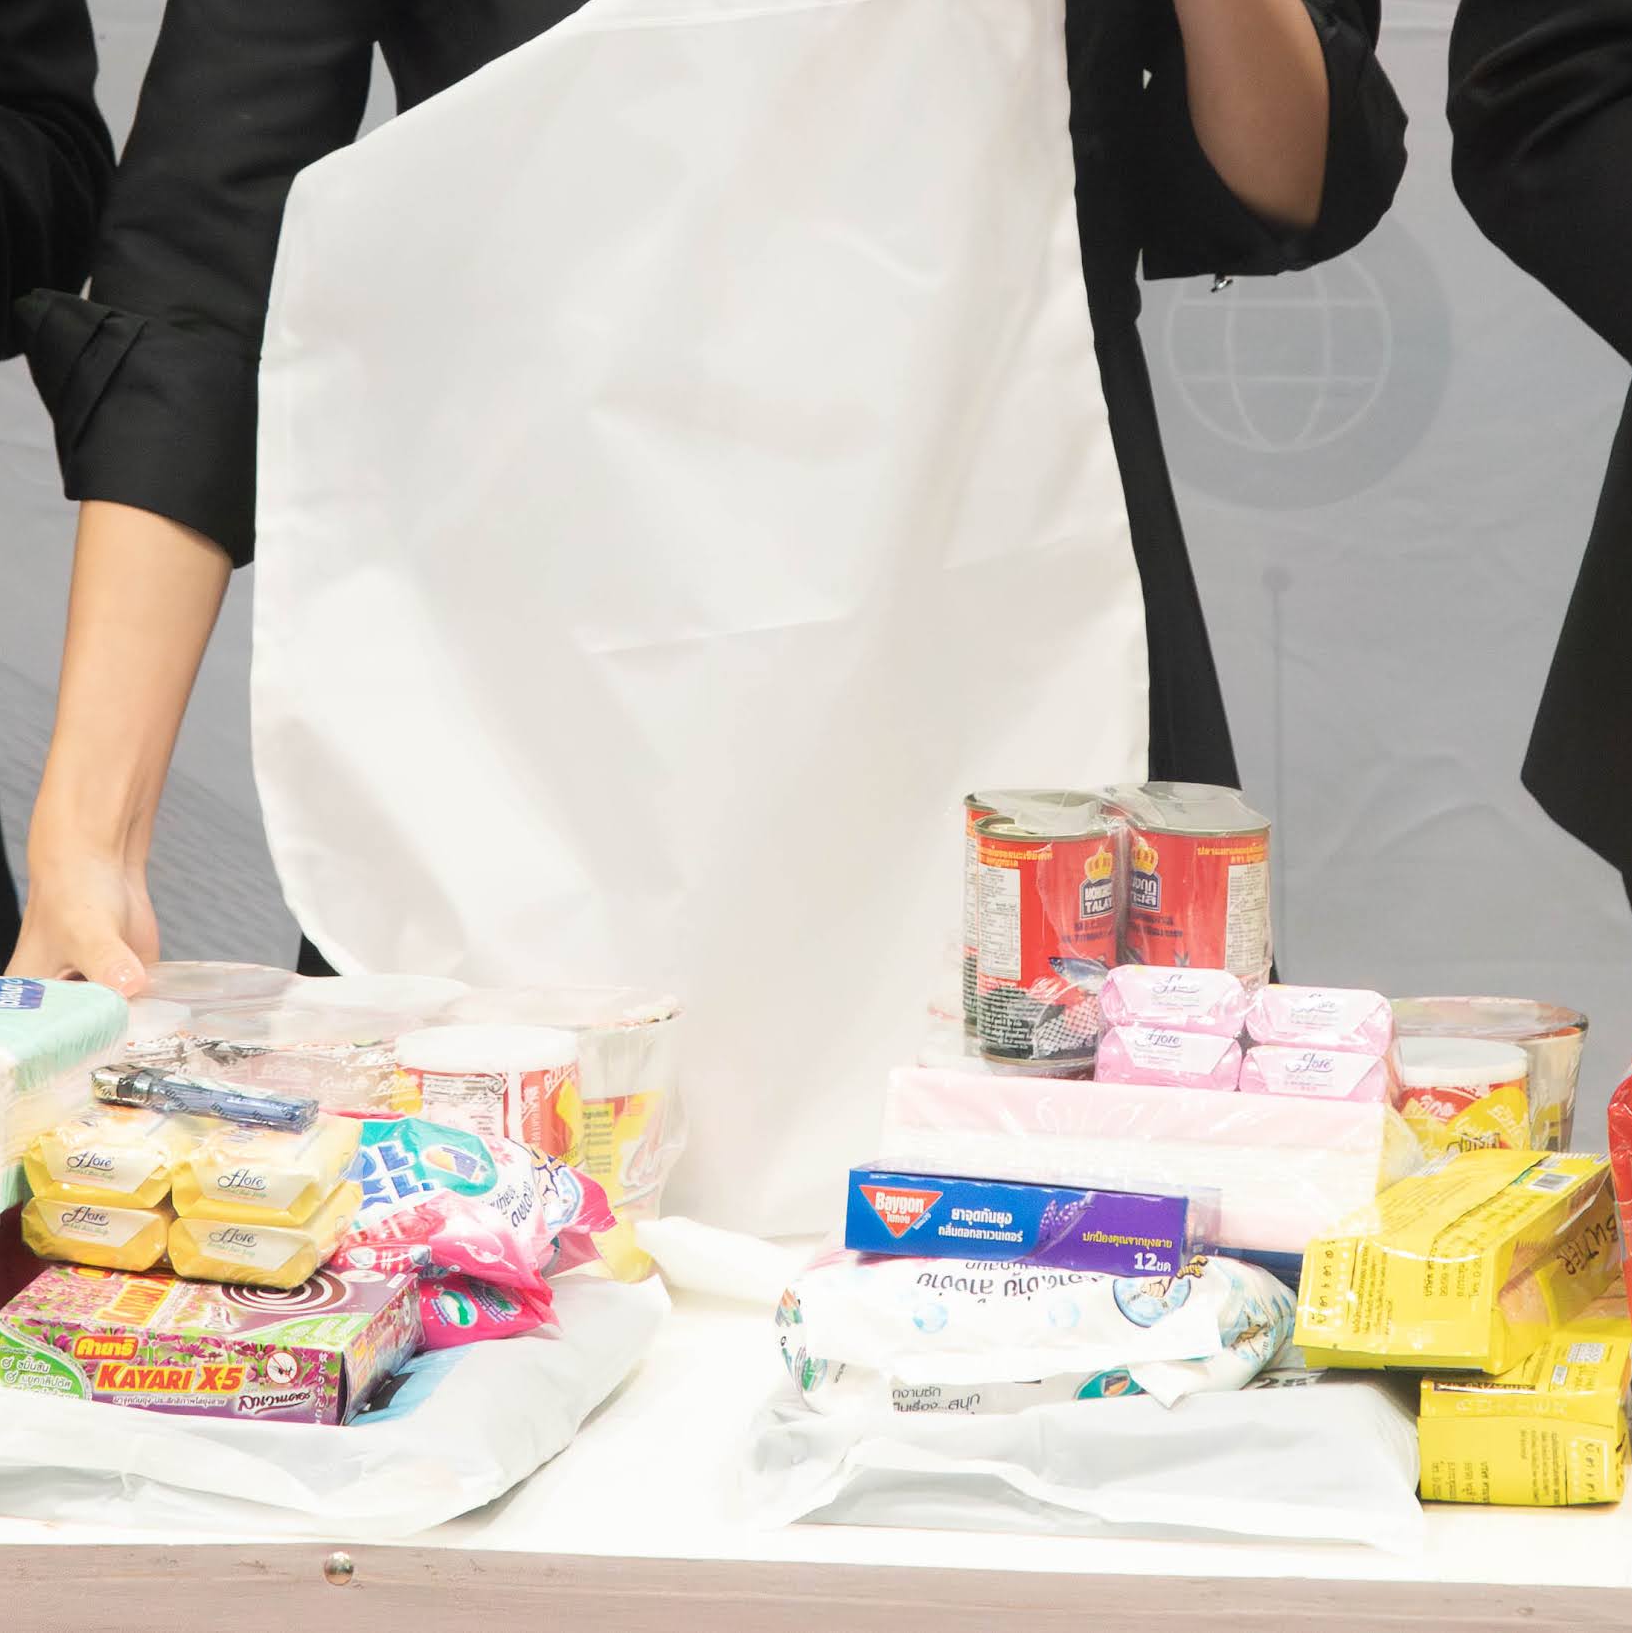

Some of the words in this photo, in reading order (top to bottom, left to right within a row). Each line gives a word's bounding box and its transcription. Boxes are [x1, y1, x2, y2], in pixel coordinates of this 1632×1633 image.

[874, 1191, 925, 1214] Baygon
[951, 1207, 1013, 1226] ยาจุดกันยุง
[938, 1223, 1023, 1243] กลิ่นดอกลาเวนเดอร์
[1082, 1231, 1173, 1250] ปกป้องคุณจากยุงลาย
[77, 1337, 136, 1357] คายาริ
[96, 1363, 193, 1392] KAYARI
